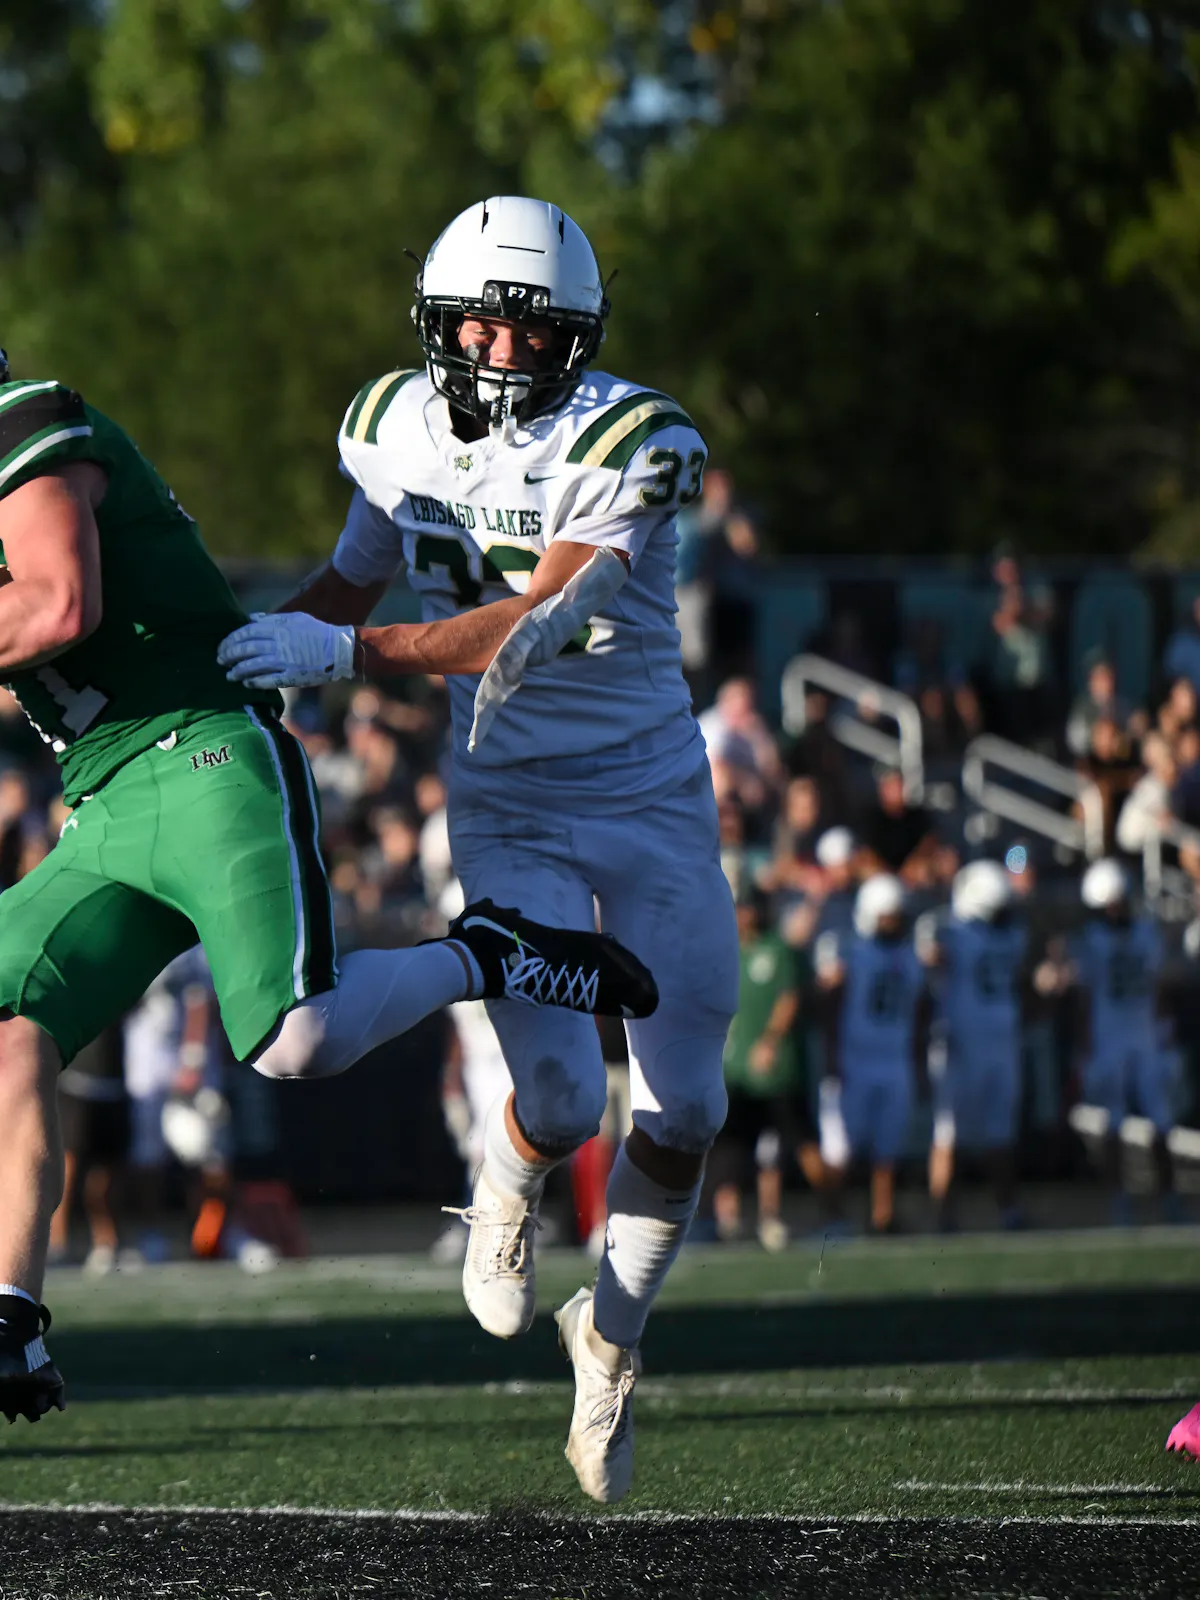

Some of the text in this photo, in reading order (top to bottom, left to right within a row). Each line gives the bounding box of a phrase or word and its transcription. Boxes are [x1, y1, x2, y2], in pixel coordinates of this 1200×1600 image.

[507, 286, 527, 299] F7
[637, 446, 706, 508] 33
[408, 493, 542, 537] CHISAGO LAKES
